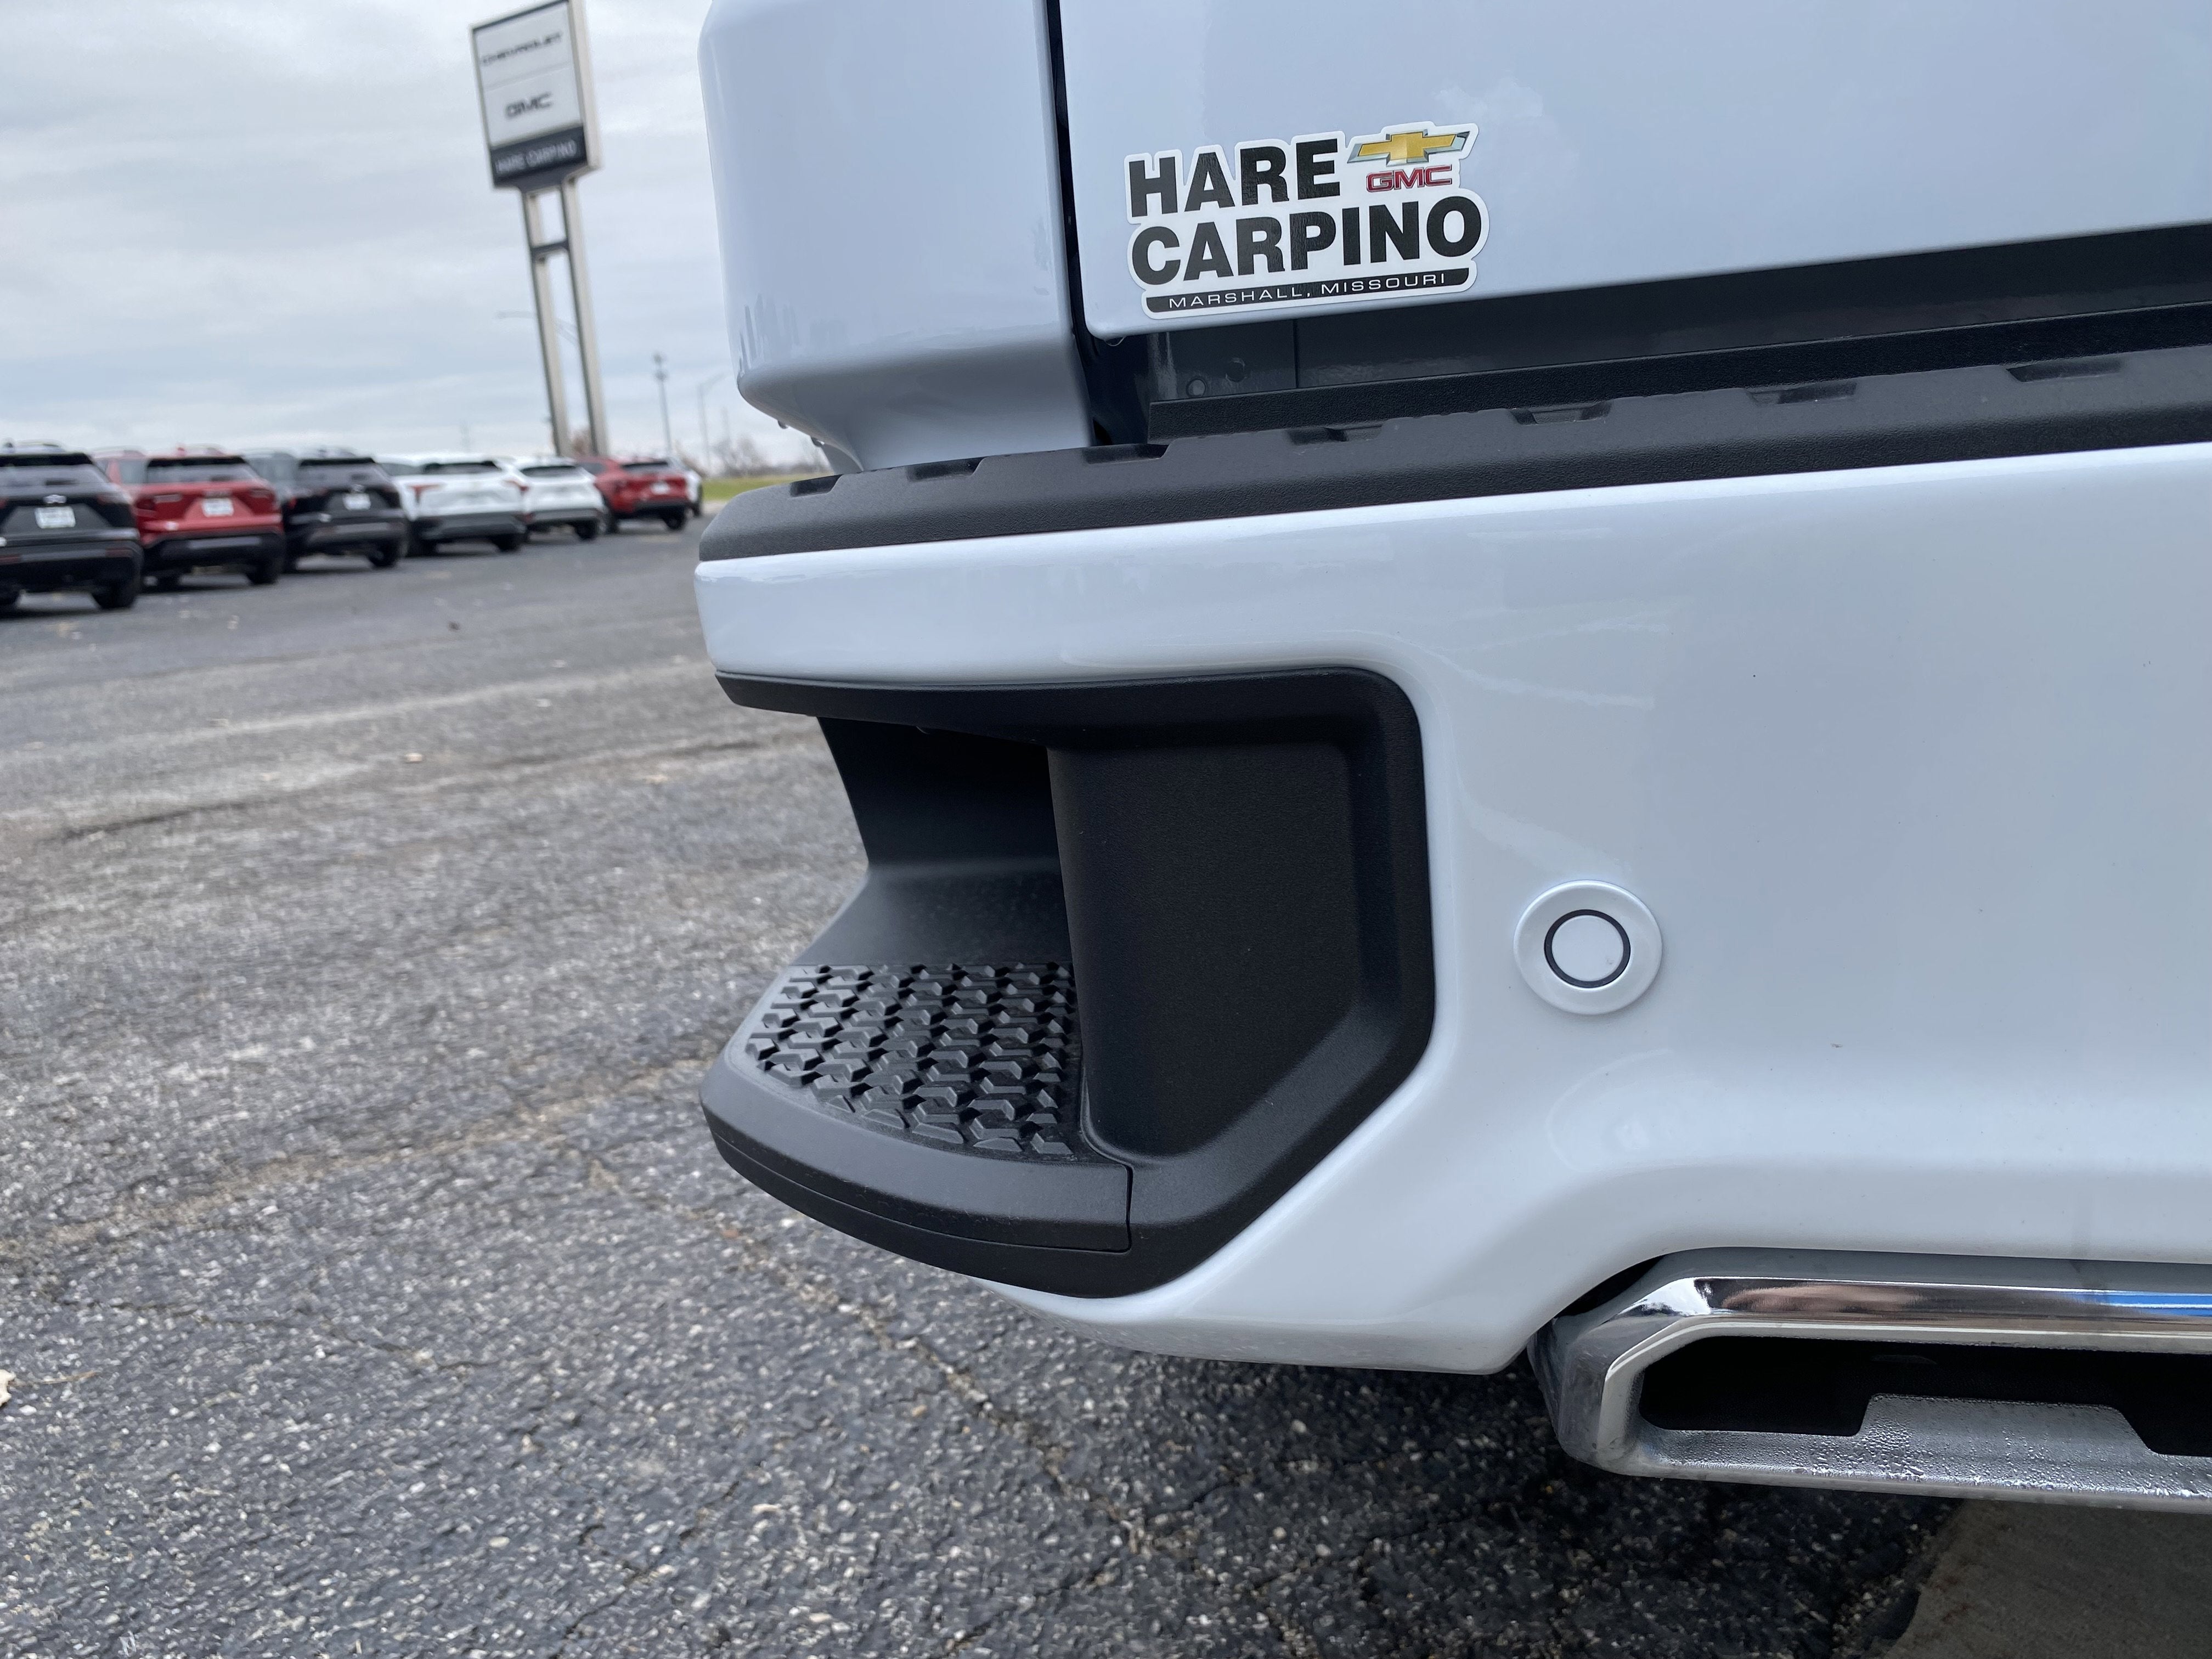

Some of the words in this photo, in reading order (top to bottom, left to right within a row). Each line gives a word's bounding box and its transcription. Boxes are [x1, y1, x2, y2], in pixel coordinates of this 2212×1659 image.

[505, 92, 552, 119] GMC
[1129, 138, 1340, 217] HARE
[1365, 165, 1452, 193] GMC
[1132, 196, 1482, 286] CARPINO
[1169, 287, 1311, 308] MARSHALL,
[1321, 273, 1444, 294] MISSOURI
